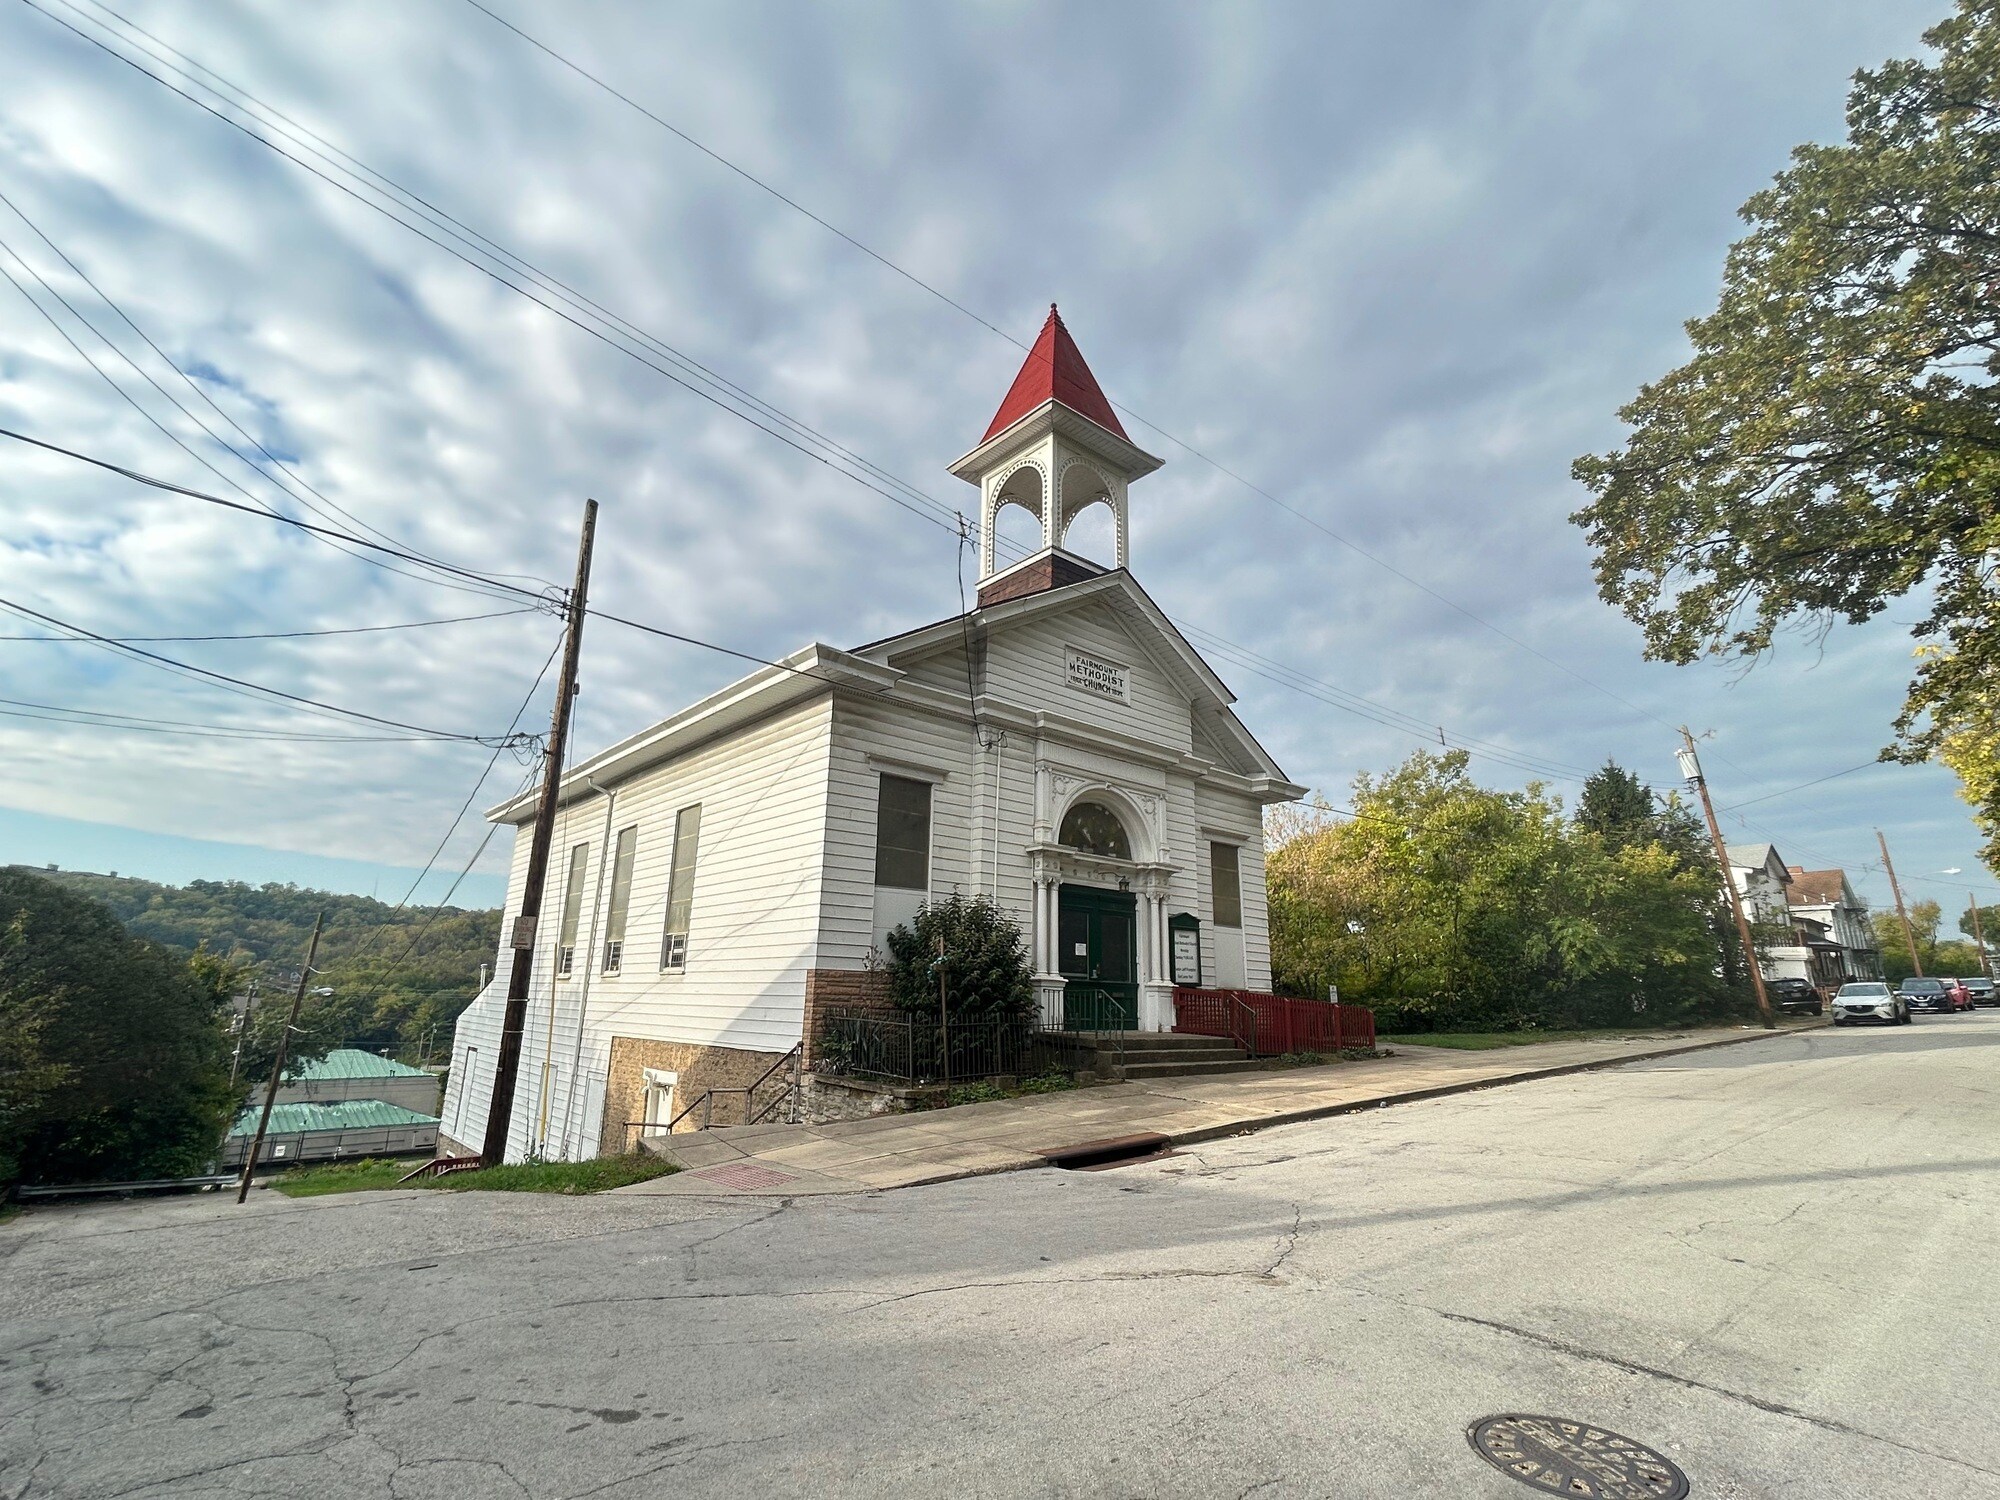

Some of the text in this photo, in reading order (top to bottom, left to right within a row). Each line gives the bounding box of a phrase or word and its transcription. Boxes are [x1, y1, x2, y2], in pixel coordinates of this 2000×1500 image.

[1069, 662, 1124, 687] METHODIST
[1076, 656, 1118, 676] FAIRMOUNT
[1083, 678, 1111, 694] CHURCH
[1514, 1420, 1646, 1498] SEWER
